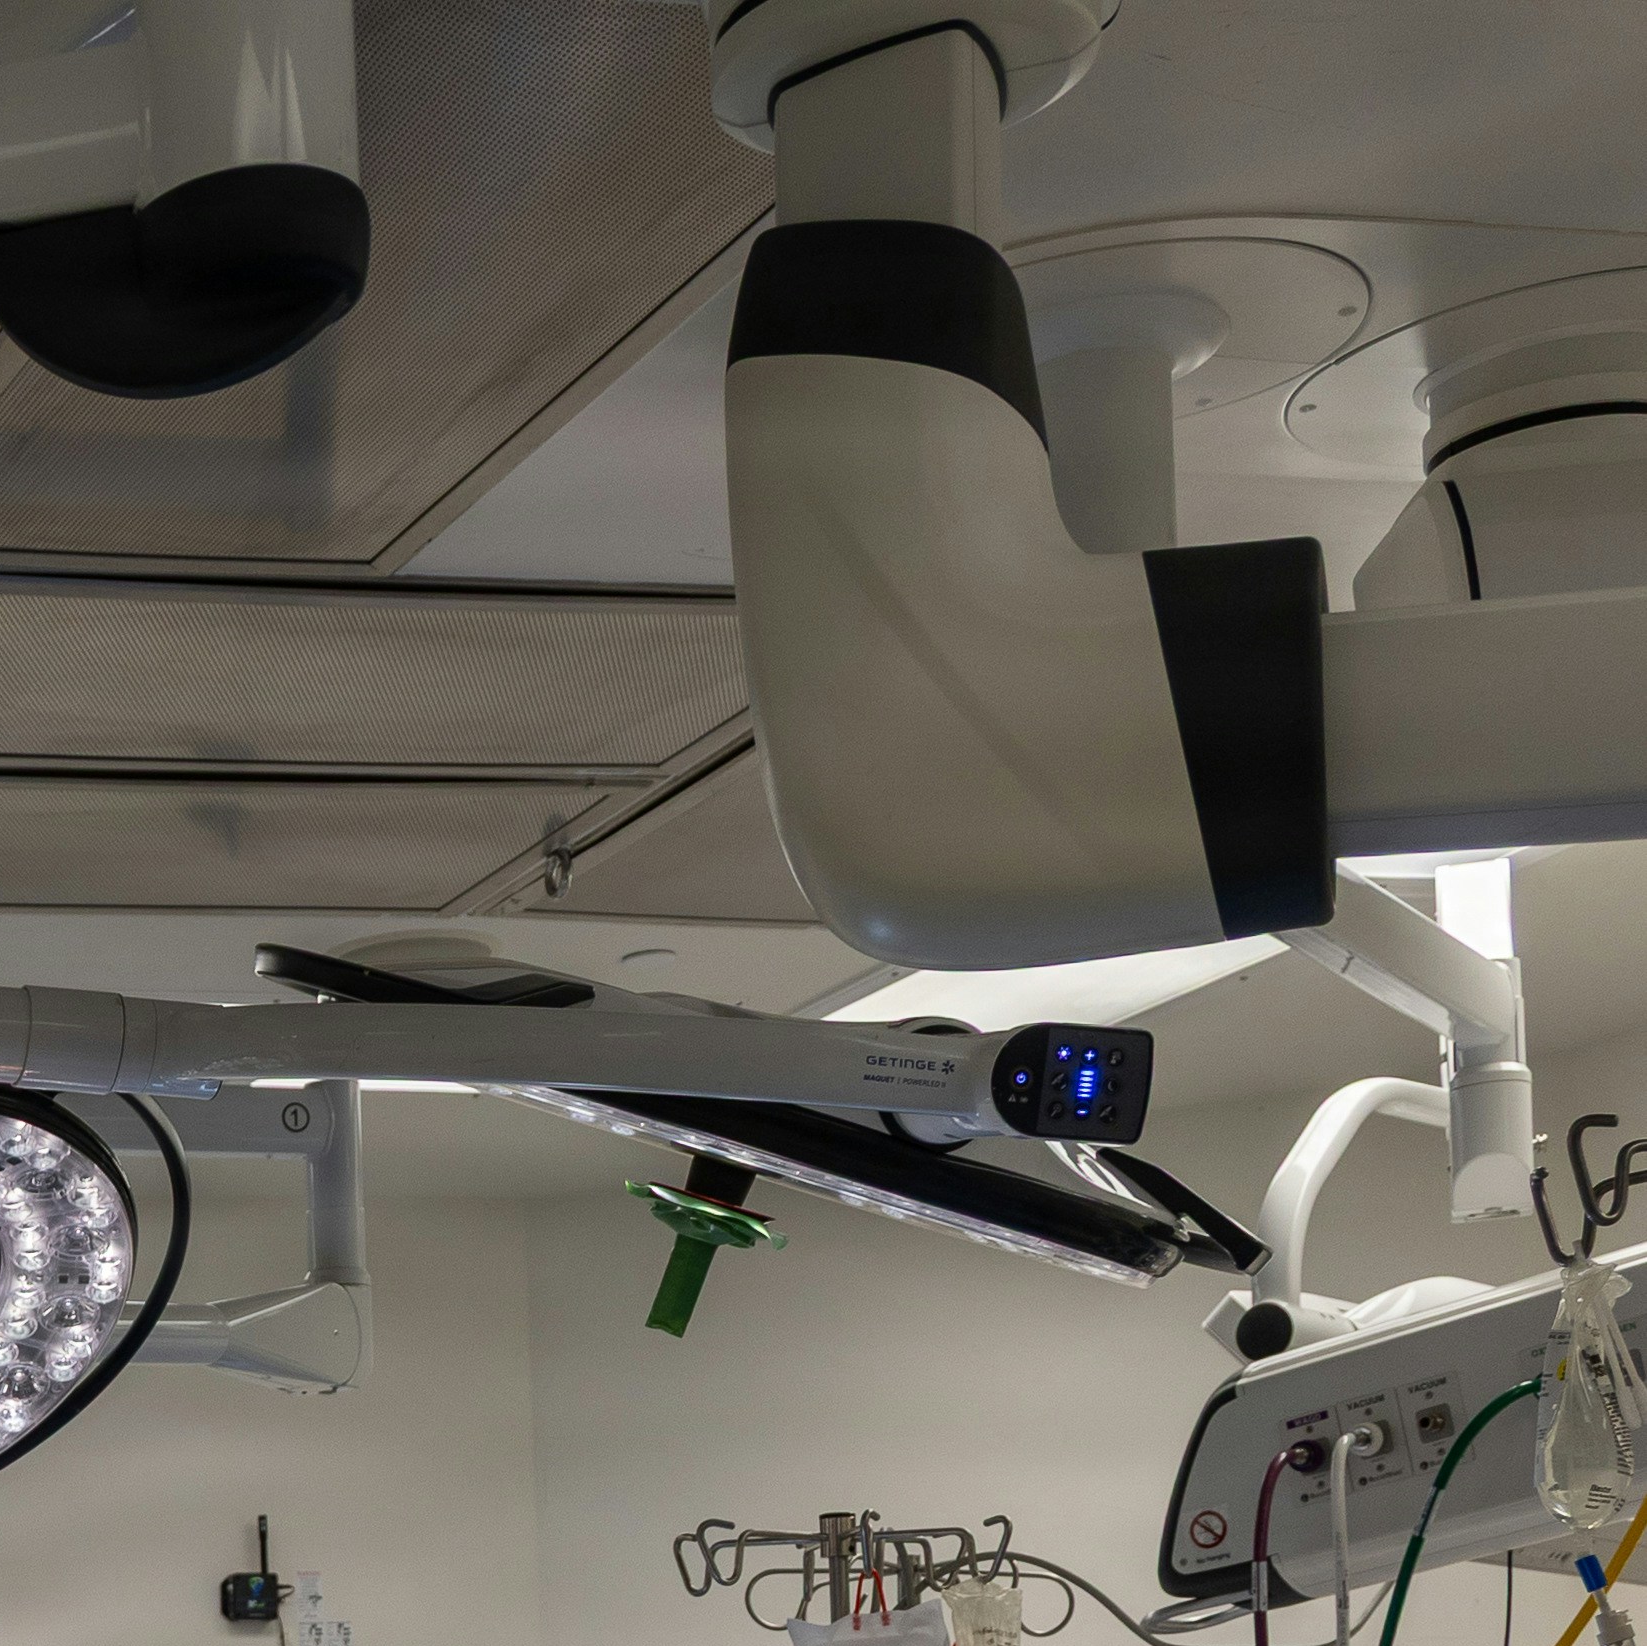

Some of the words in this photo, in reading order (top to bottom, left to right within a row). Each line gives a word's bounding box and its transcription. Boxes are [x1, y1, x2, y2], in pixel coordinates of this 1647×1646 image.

[866, 1055, 936, 1071] GETINGE
[863, 1074, 895, 1083] MAQUET
[902, 1077, 940, 1088] POWERLED
[1407, 1377, 1447, 1394] VACUUM
[1346, 1394, 1385, 1411] VACUUM
